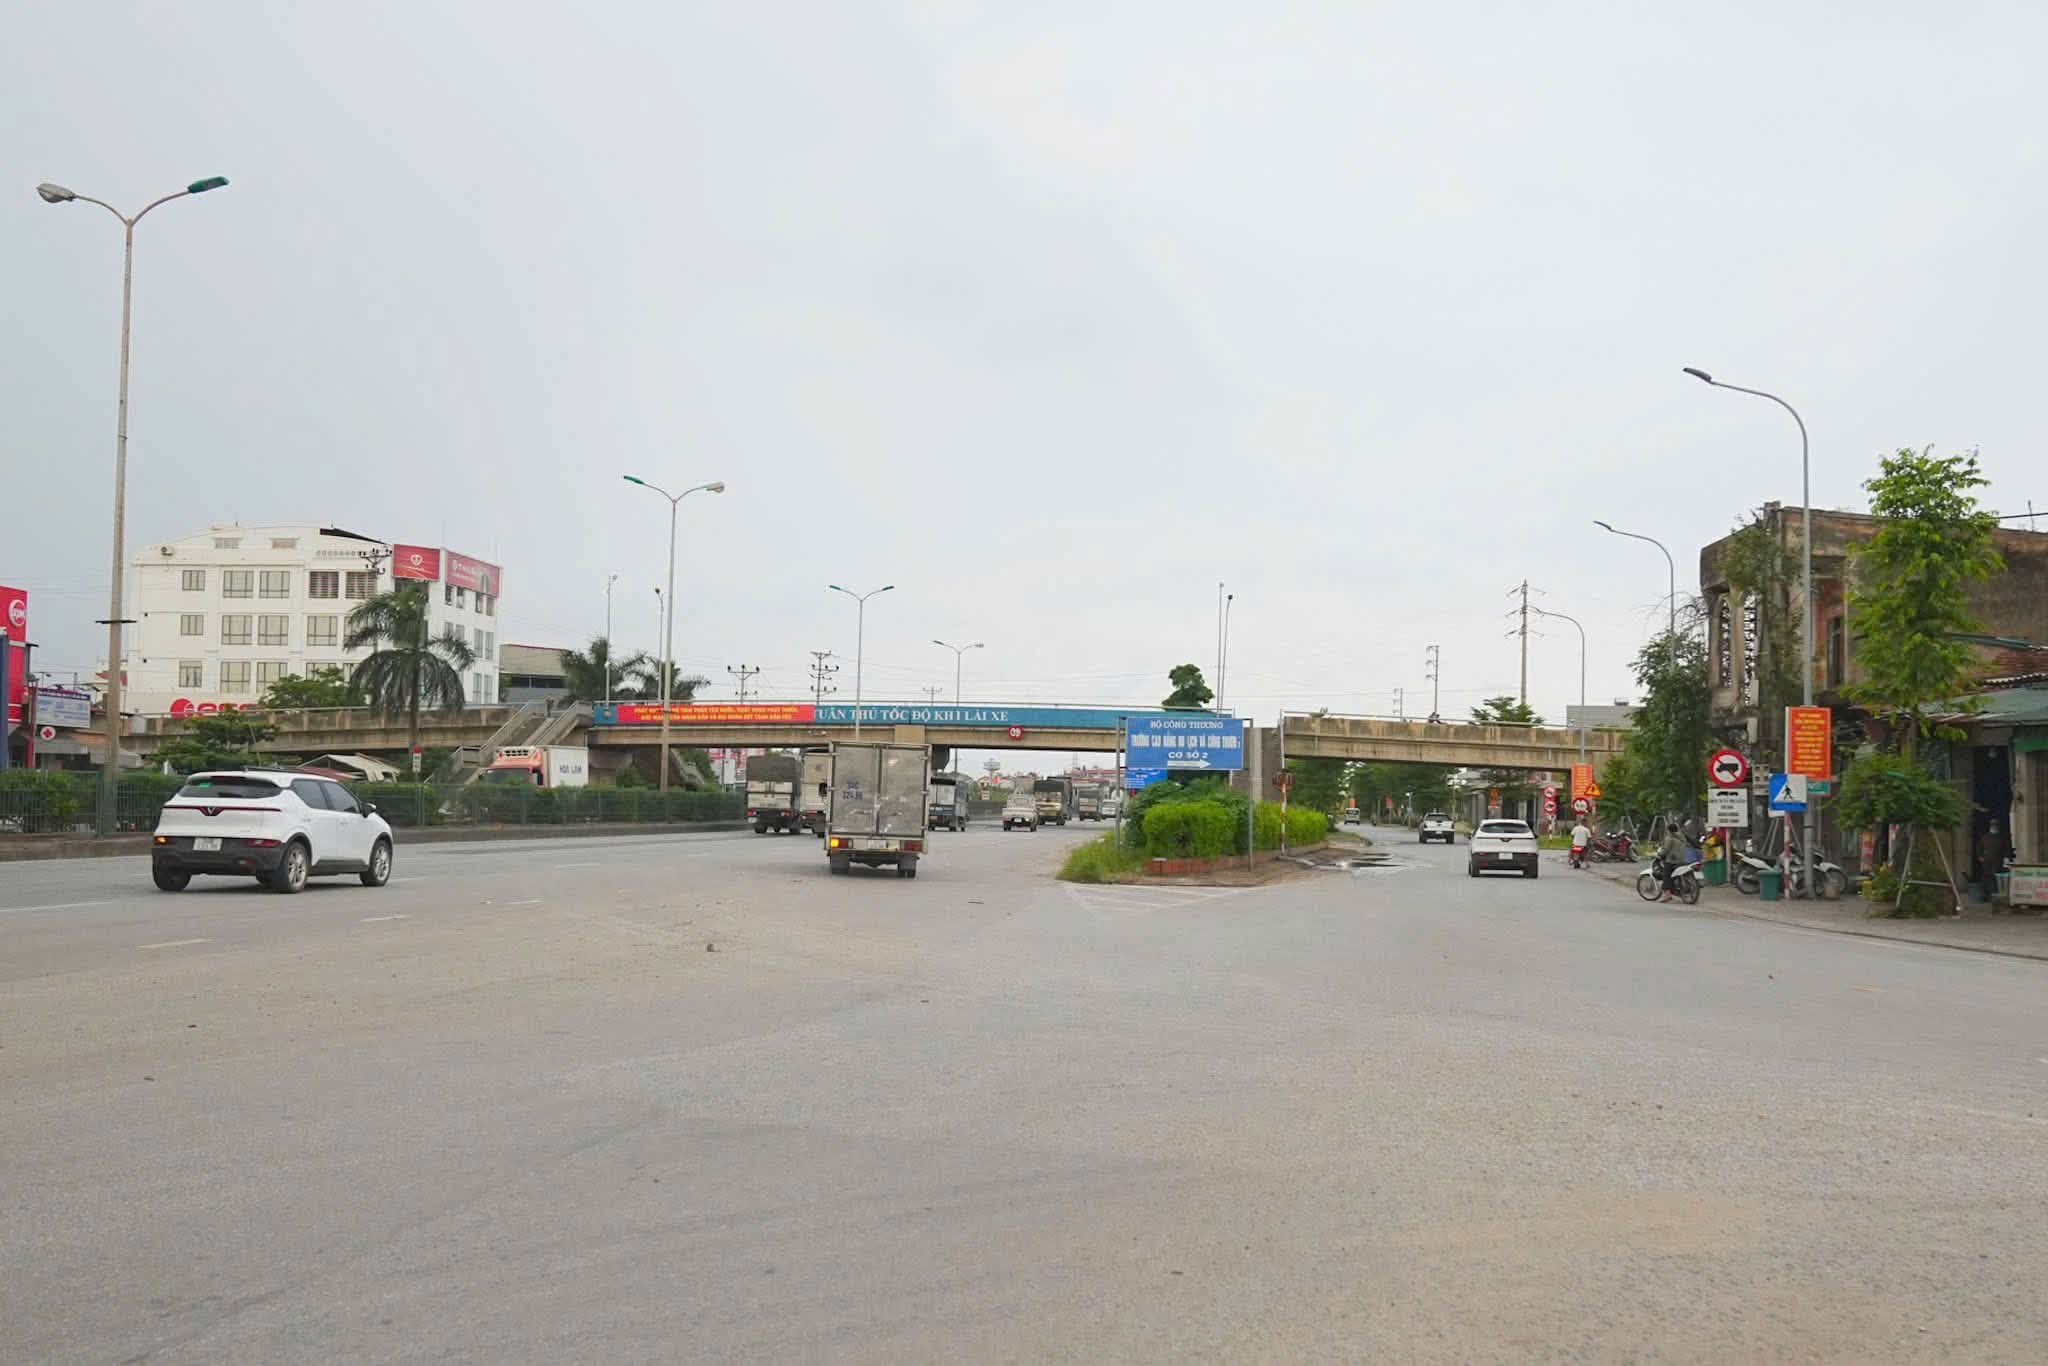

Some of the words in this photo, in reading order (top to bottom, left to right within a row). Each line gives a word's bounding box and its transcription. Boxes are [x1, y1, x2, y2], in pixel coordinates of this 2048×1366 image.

[849, 707, 877, 720] THỦ
[880, 707, 909, 720] TỐC
[911, 709, 931, 723] ĐỘ
[934, 710, 960, 720] KHI
[965, 709, 986, 721] LÁI
[991, 711, 1008, 721] XE
